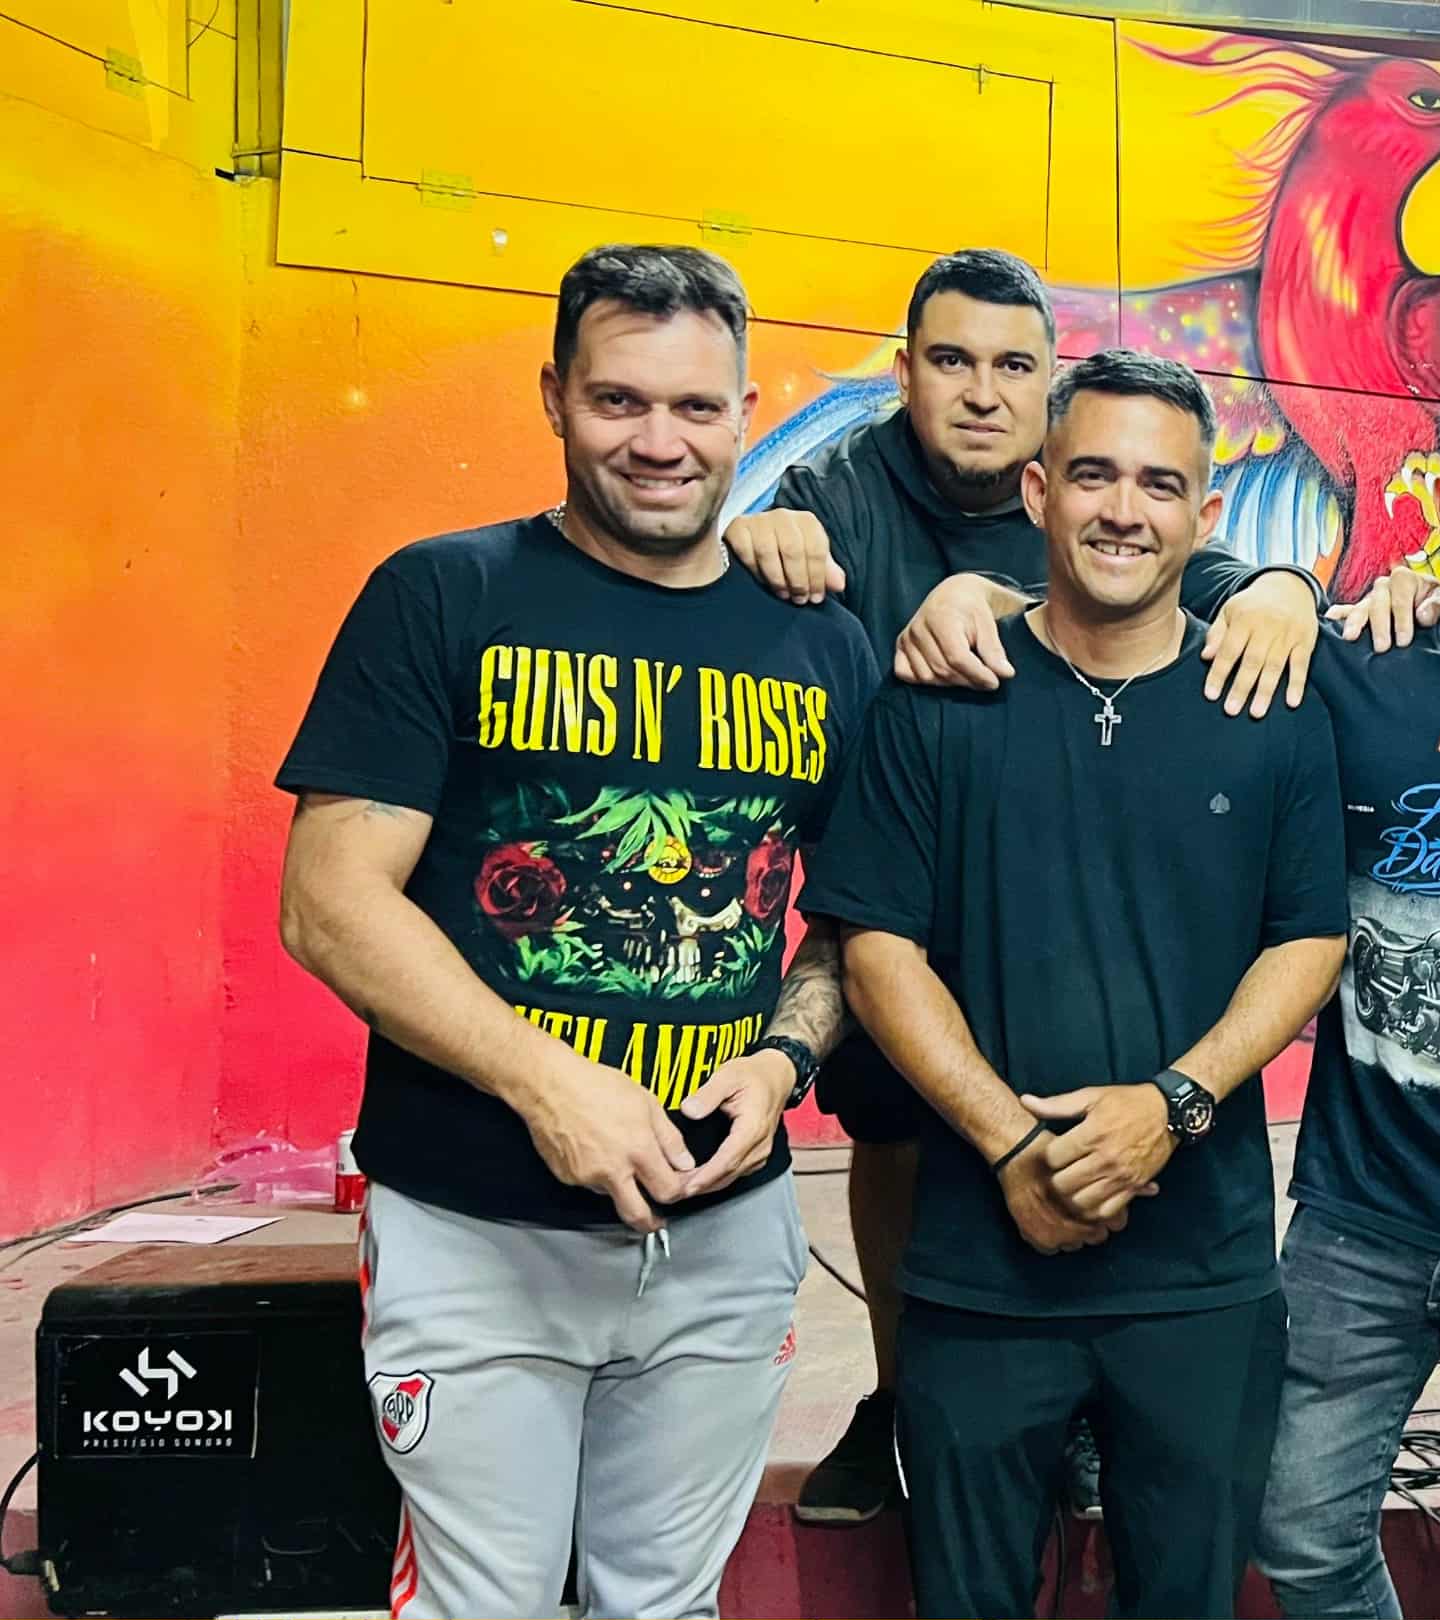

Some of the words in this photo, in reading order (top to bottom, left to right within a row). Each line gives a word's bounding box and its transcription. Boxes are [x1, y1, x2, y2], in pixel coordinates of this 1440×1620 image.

[478, 645, 618, 757] GUNS
[697, 667, 827, 784] ROSES
[621, 1012, 763, 1111] AMER
